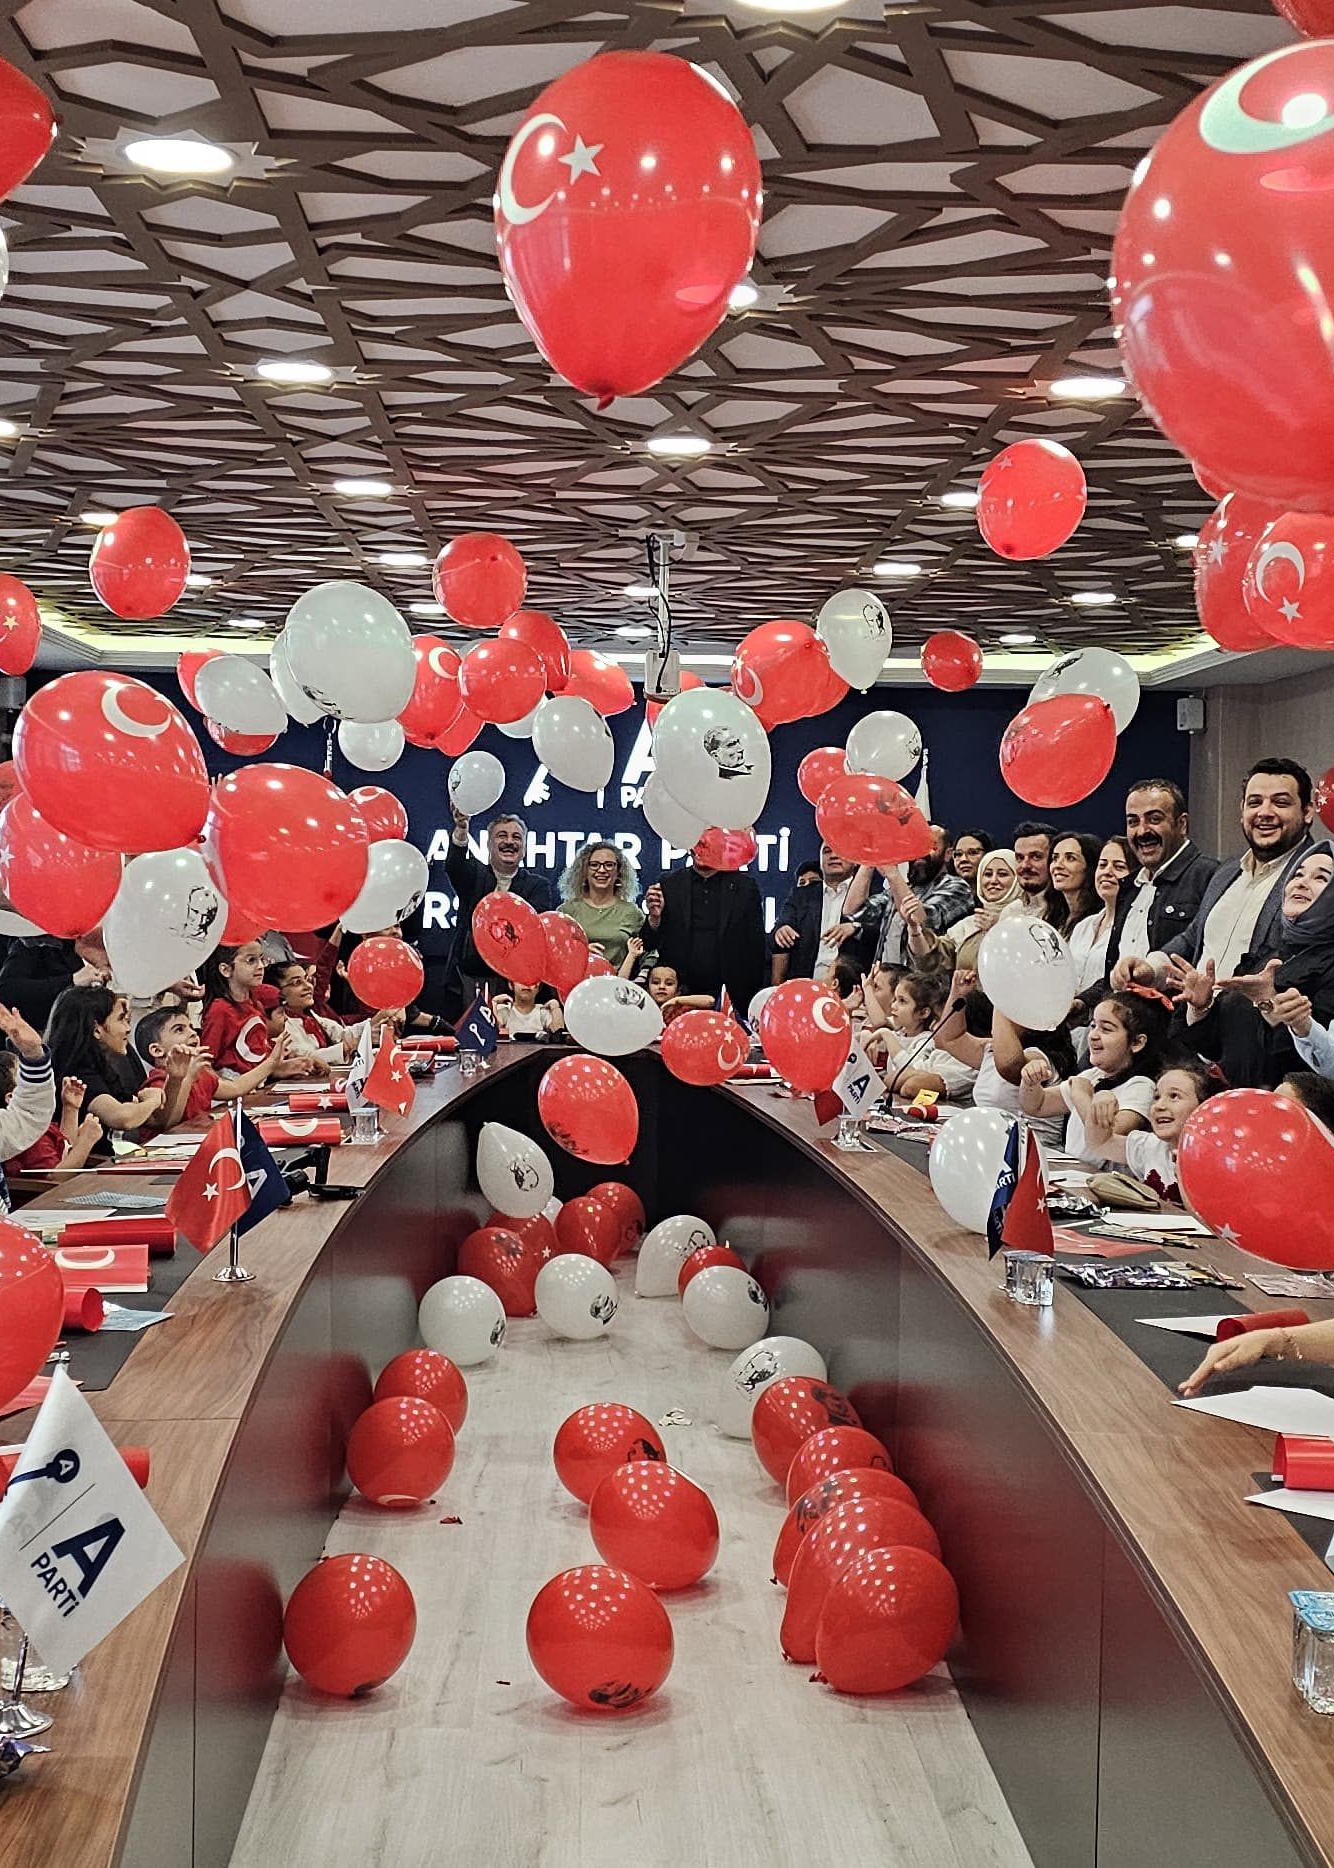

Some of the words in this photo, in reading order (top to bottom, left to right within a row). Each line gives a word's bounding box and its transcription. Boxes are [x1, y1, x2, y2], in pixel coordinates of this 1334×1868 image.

[661, 827, 790, 872] PTİ
[852, 1074, 871, 1098] A
[51, 1517, 126, 1599] A
